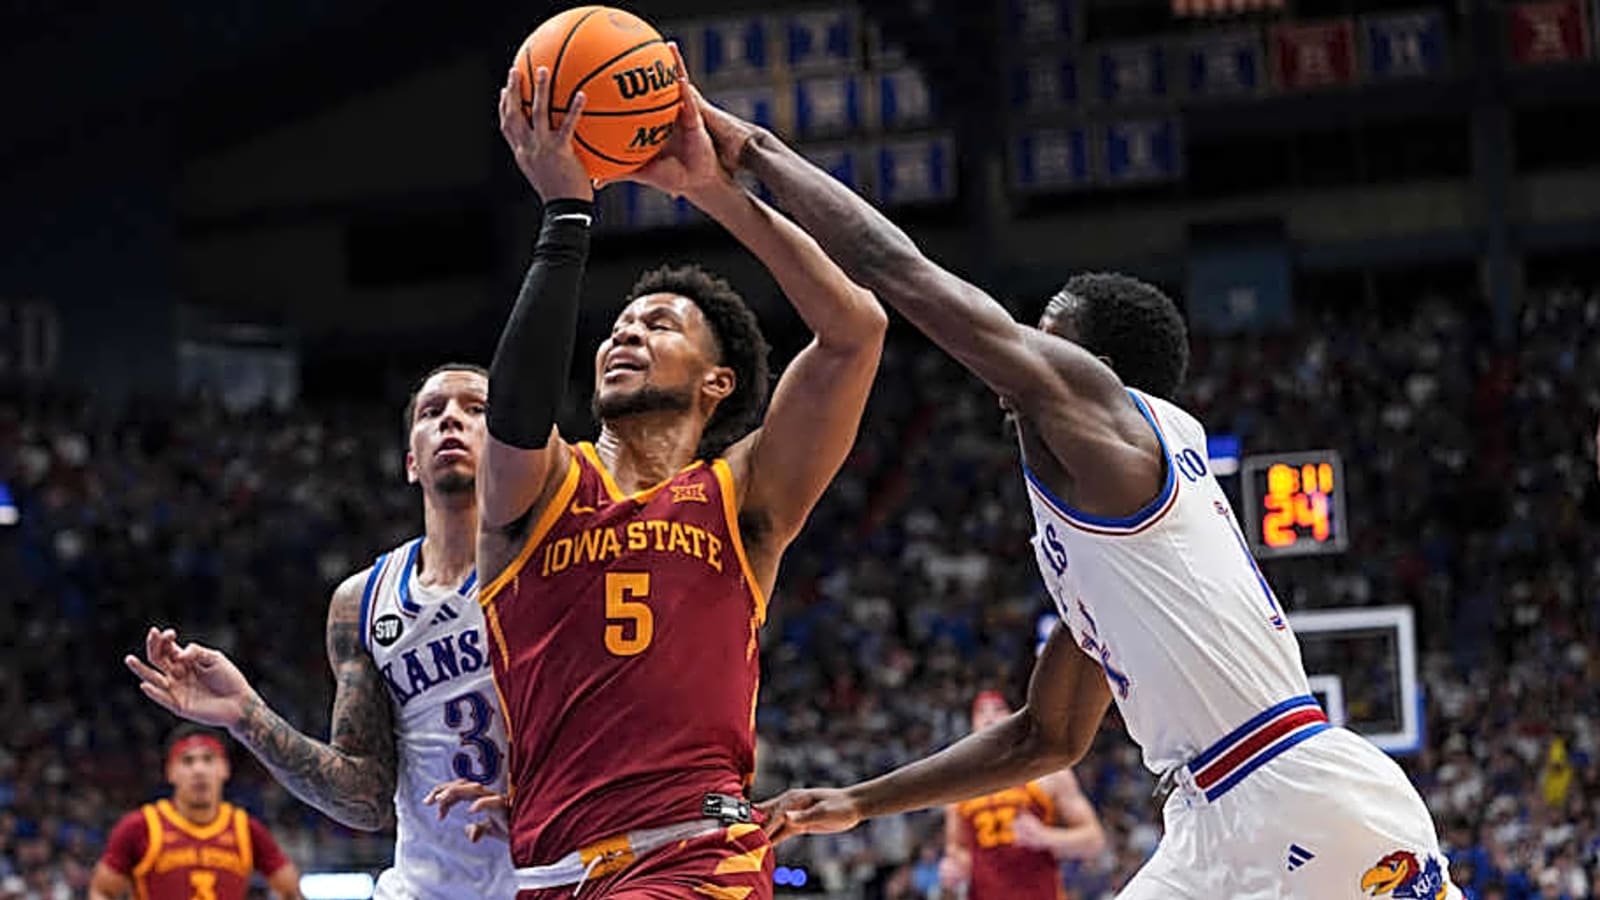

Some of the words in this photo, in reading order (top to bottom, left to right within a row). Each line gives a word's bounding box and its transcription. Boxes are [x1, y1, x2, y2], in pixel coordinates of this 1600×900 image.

[613, 60, 679, 99] Wils
[1263, 492, 1328, 547] 24
[542, 528, 622, 577] IOWA
[627, 520, 723, 573] STATE
[375, 619, 399, 640] SW
[603, 571, 654, 657] 5
[381, 629, 491, 707] KANS
[444, 690, 503, 786] 3
[1411, 874, 1432, 897] KU
